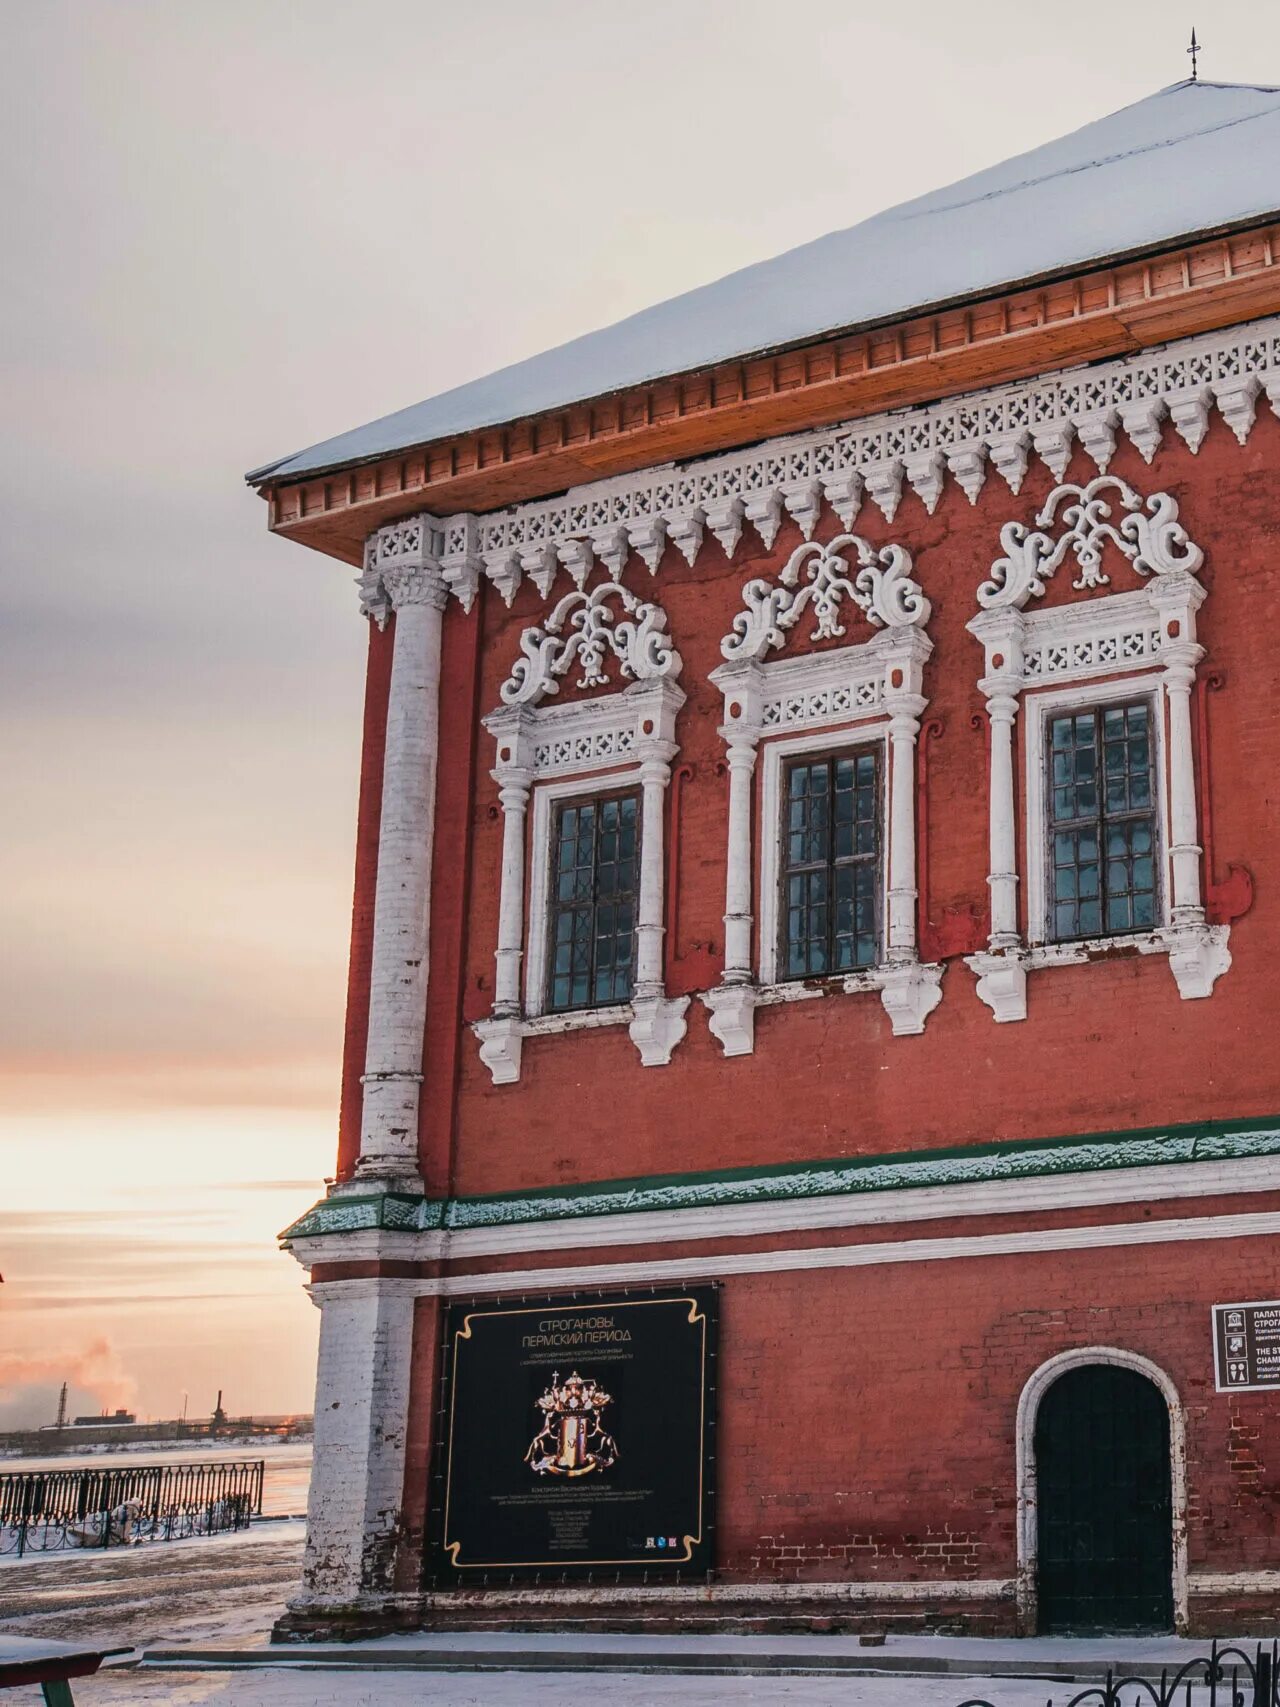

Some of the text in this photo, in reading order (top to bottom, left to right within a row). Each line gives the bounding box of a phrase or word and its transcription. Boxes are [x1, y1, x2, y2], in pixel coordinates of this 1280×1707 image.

[522, 1329, 632, 1348] ПЕРМСКИЙ ПЕРИОД
[1256, 1347, 1271, 1356] THE
